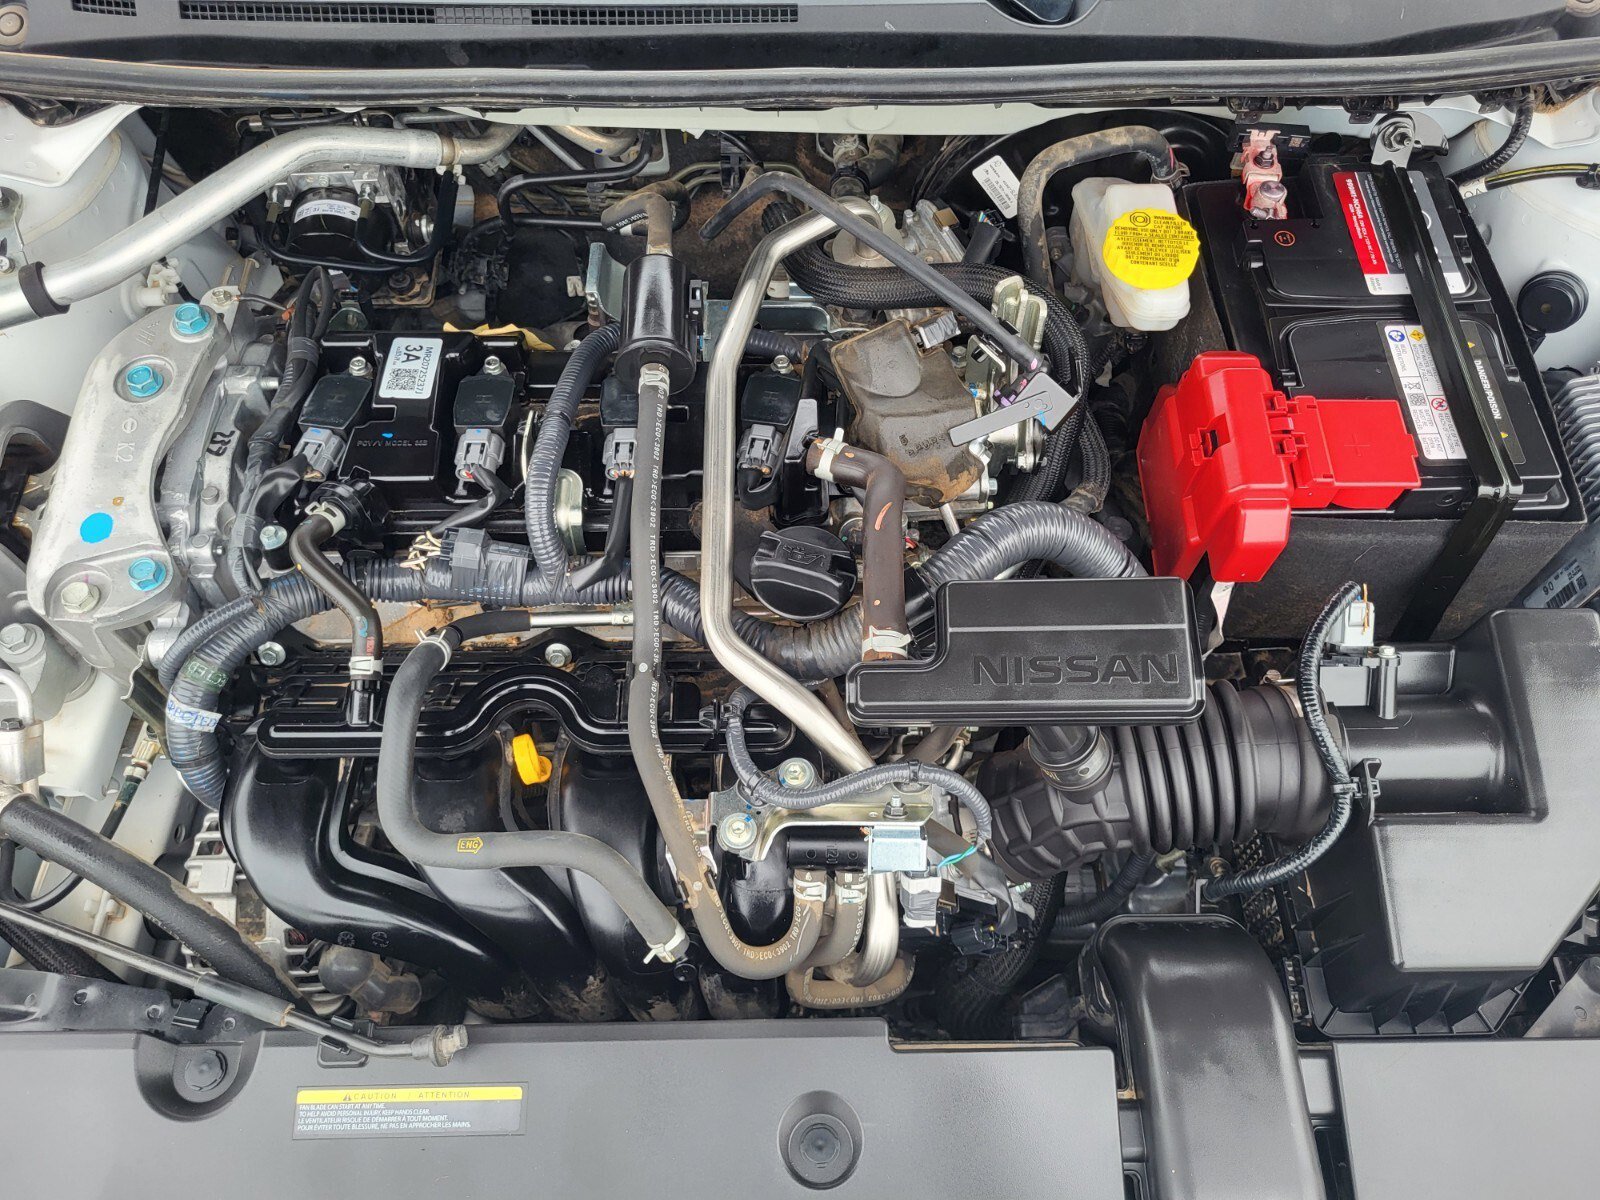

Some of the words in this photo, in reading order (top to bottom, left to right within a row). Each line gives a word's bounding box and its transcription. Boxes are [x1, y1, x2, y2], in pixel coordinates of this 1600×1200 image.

[401, 344, 423, 363] 3A
[1474, 359, 1502, 420] DANGER/POISON
[973, 654, 1179, 686] NISSAN
[460, 840, 478, 848] ENG
